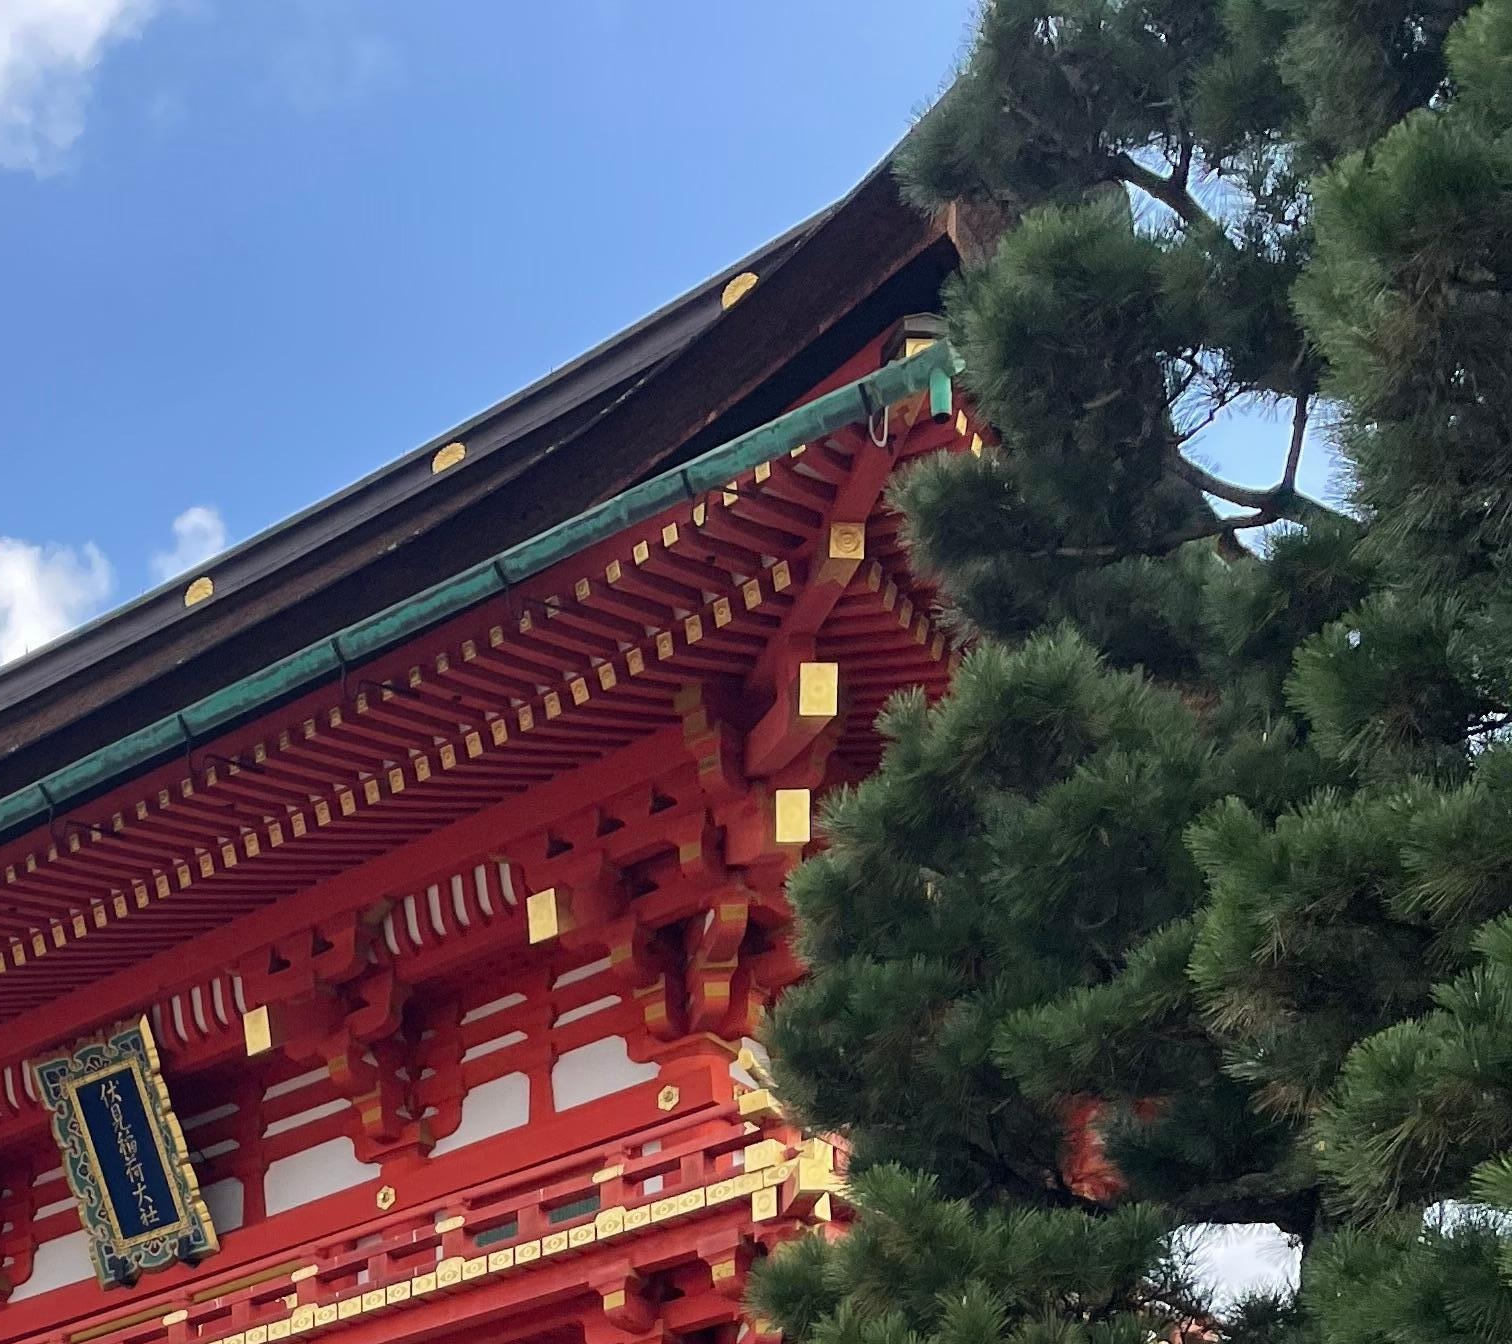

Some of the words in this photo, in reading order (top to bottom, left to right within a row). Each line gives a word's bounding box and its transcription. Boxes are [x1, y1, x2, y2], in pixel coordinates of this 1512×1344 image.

[100, 1080, 160, 1226] 伏見稲荷大社
